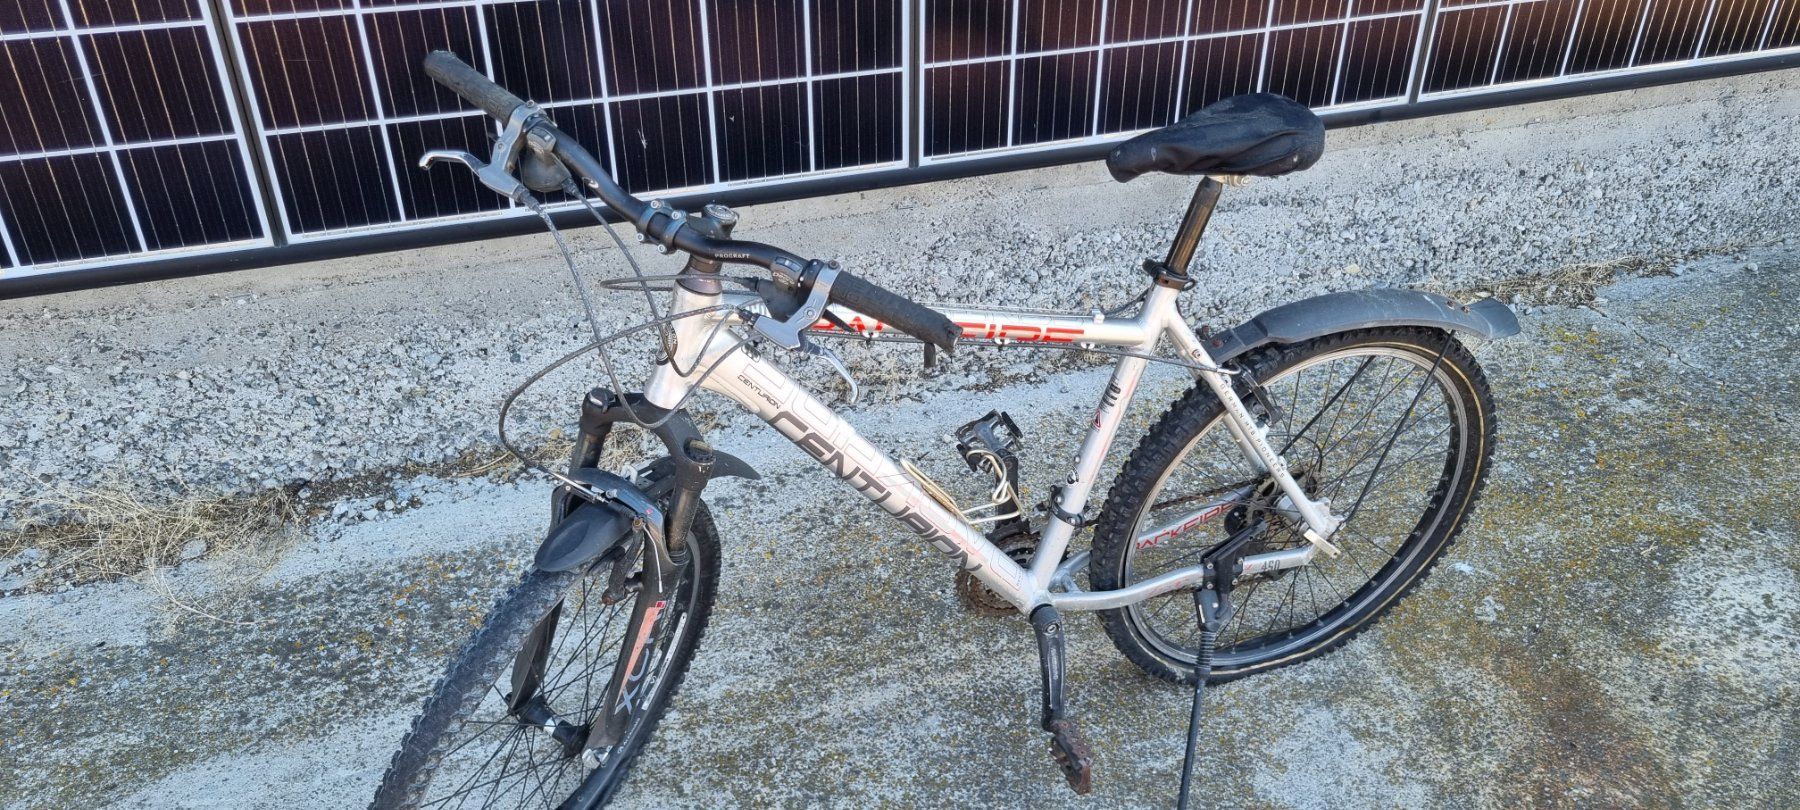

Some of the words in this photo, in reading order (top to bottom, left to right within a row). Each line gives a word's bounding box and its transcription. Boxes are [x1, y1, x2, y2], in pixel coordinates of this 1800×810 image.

[737, 373, 781, 410] CENTURION
[768, 410, 983, 572] CENTURION
[1136, 499, 1234, 550] ACKFIRE
